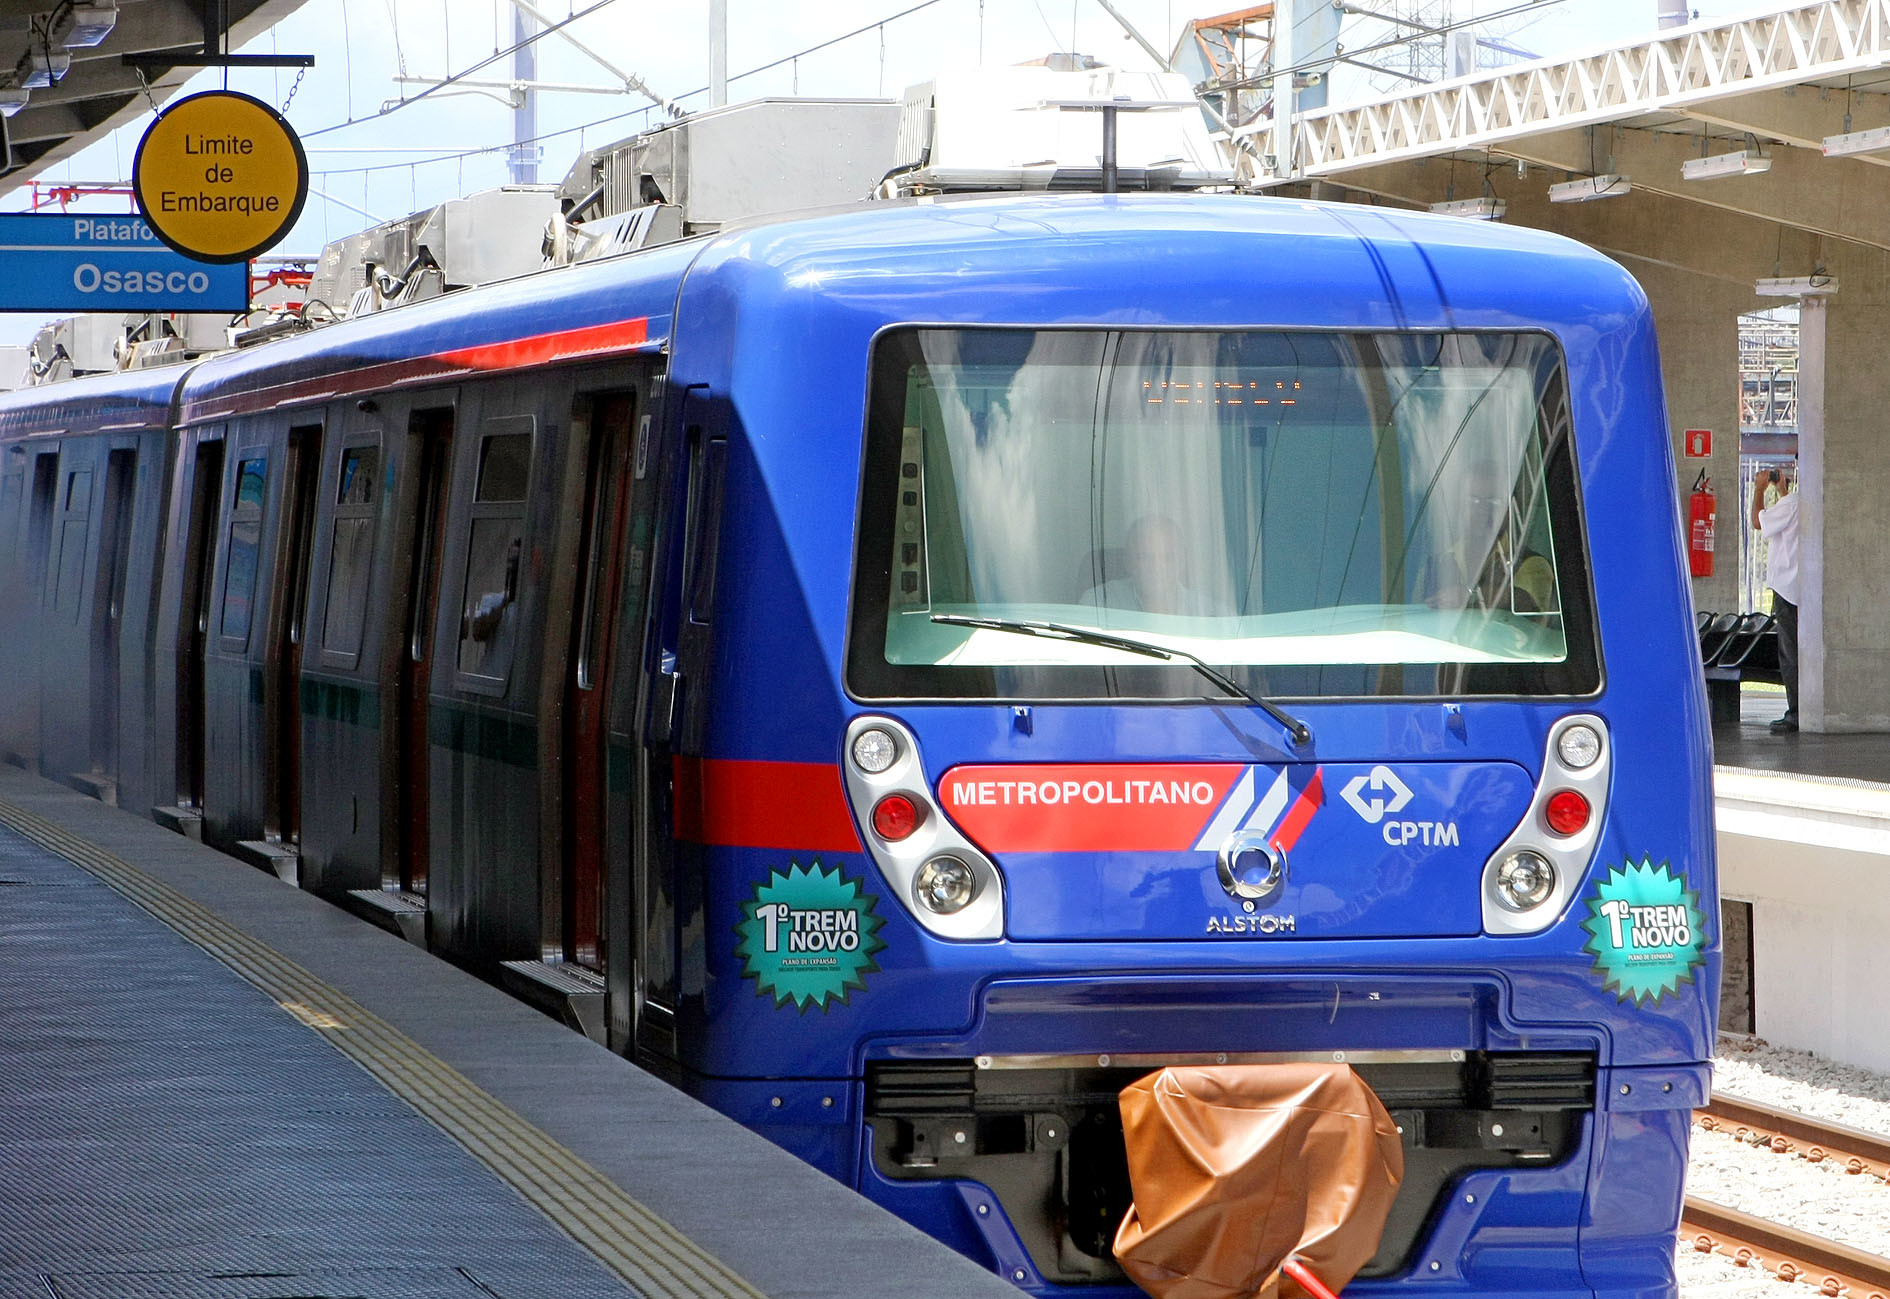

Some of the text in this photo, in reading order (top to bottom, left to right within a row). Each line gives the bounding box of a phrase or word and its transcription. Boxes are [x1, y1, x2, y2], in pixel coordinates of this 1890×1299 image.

[184, 134, 254, 156] Limite
[204, 163, 234, 185] de
[161, 191, 280, 216] Embarque
[74, 220, 158, 240] Platafo
[73, 263, 209, 294] Osasco
[952, 781, 1214, 806] METROPOLITANO
[1382, 821, 1460, 847] CPTM
[756, 904, 858, 951] 1º TREM
[1206, 916, 1296, 933] ALSTOM
[1600, 900, 1687, 948] 1º TREM
[789, 931, 859, 951] NOVO
[1631, 926, 1691, 948] NOVO
